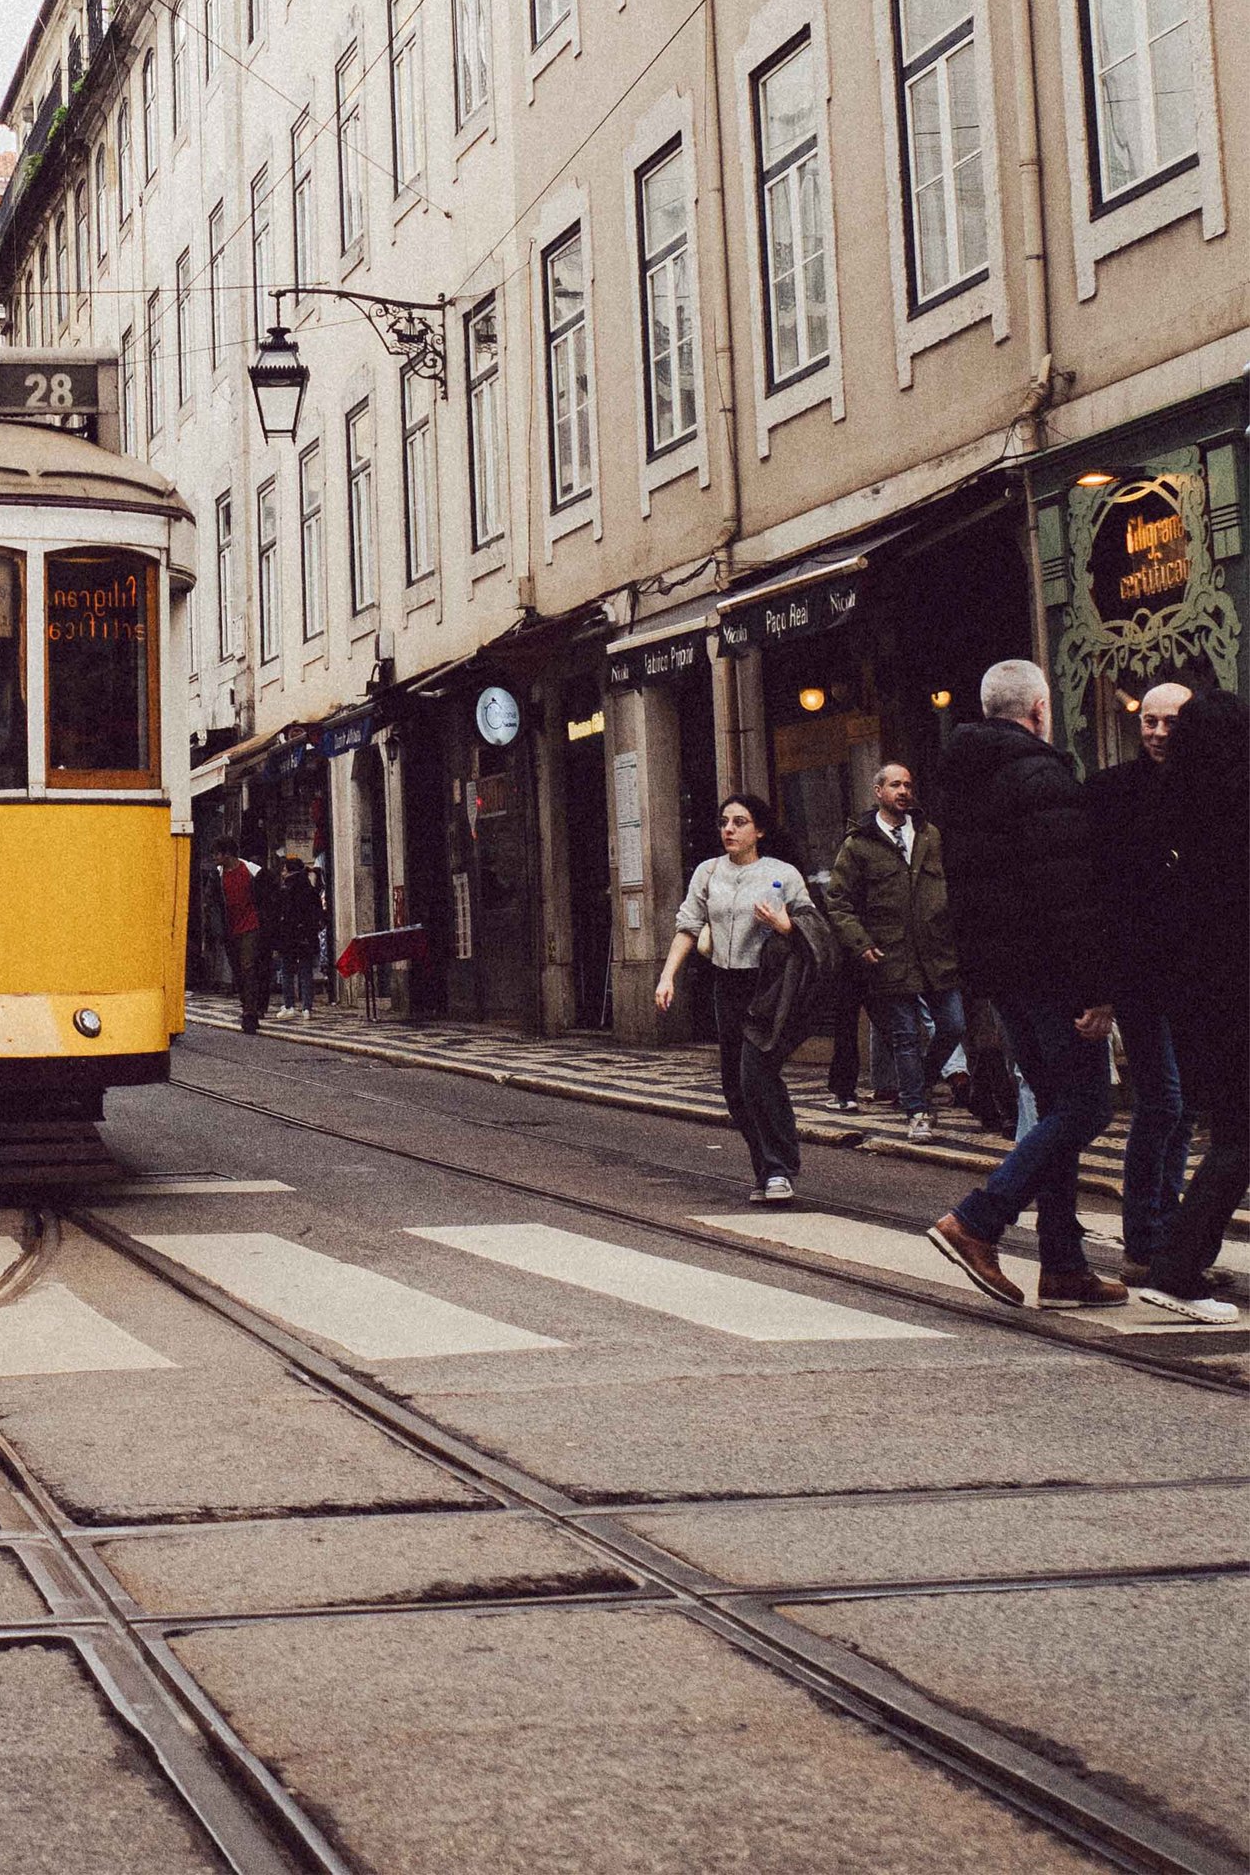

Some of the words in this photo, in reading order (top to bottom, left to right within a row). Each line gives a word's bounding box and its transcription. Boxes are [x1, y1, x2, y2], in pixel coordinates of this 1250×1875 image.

[24, 373, 73, 408] 28
[766, 610, 787, 638] Paço
[790, 599, 809, 628] Real
